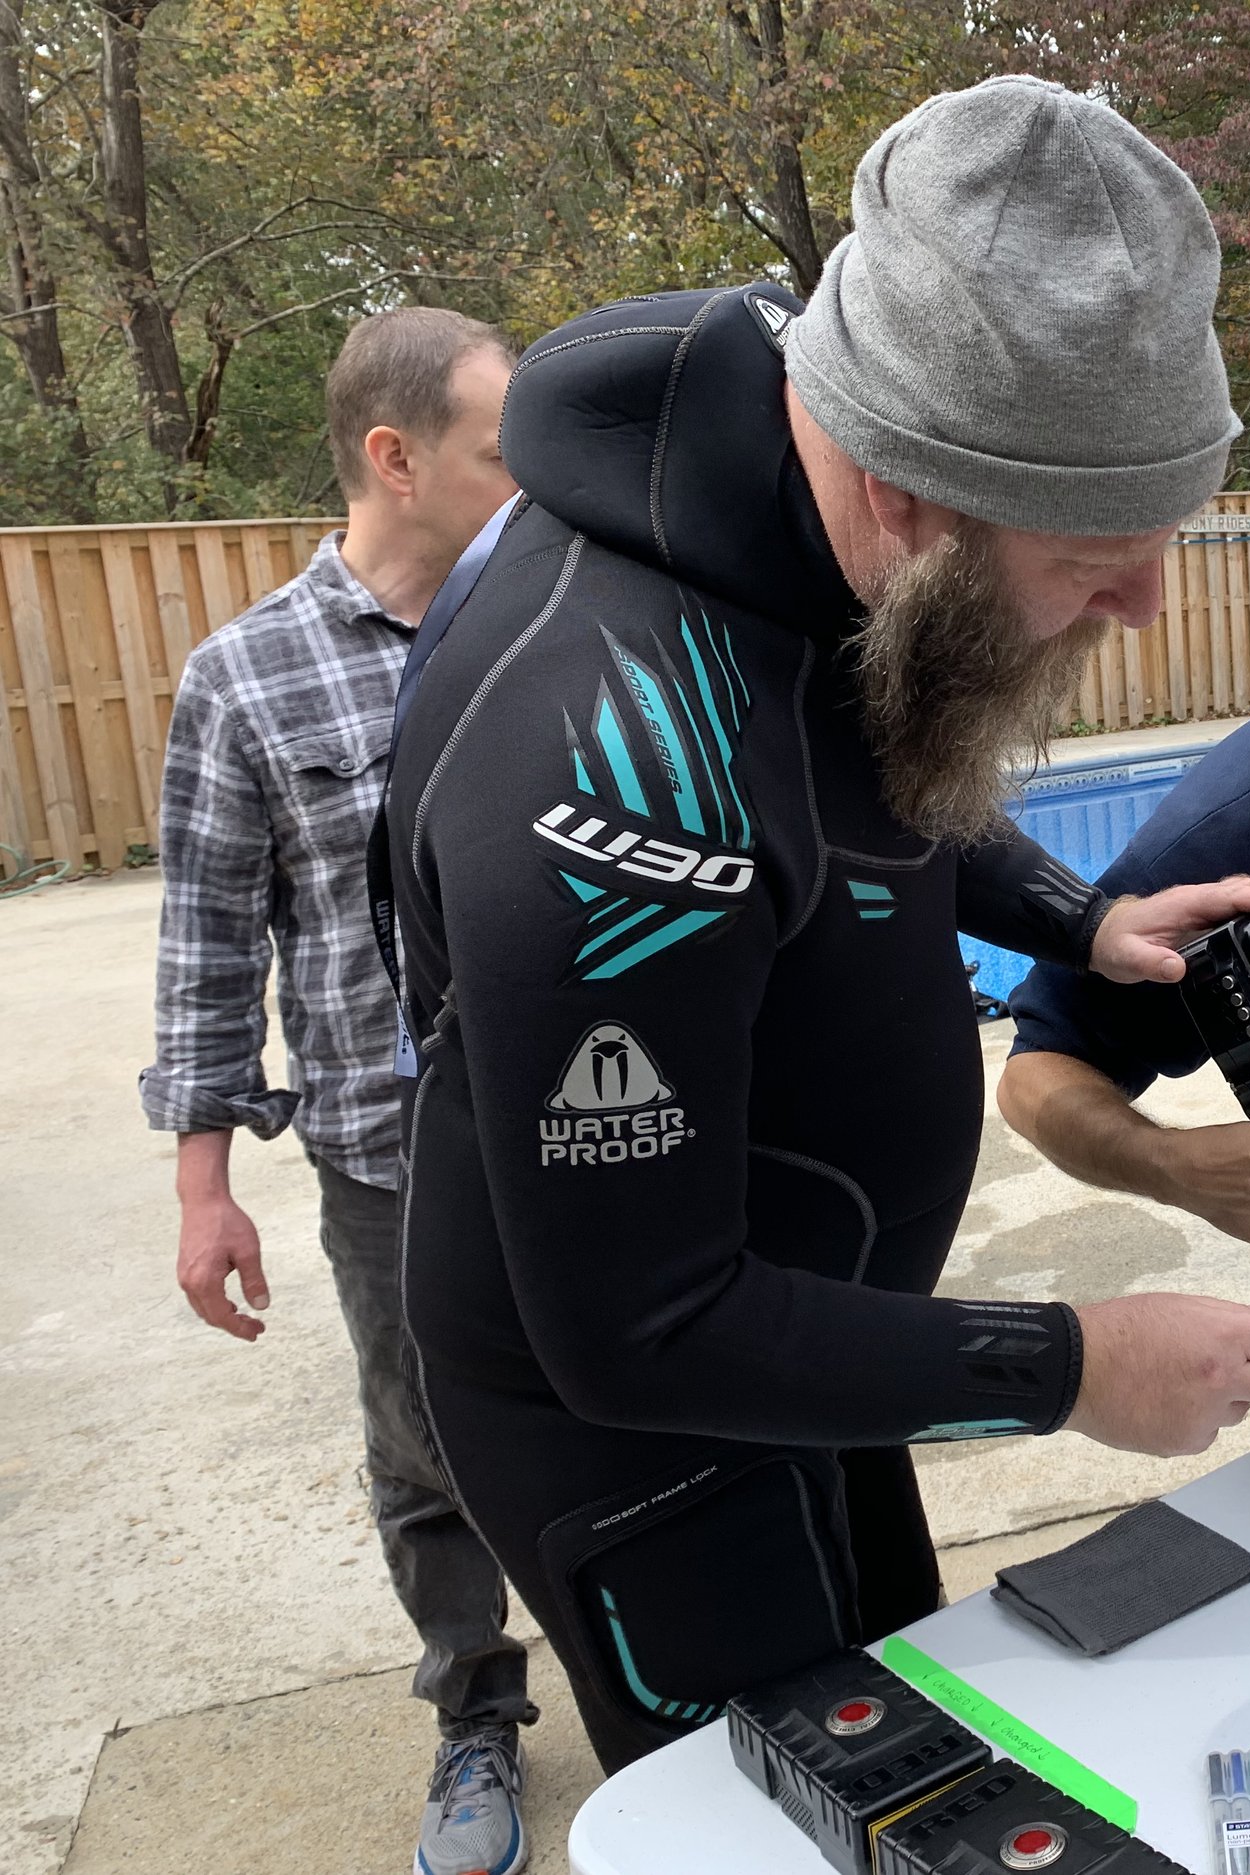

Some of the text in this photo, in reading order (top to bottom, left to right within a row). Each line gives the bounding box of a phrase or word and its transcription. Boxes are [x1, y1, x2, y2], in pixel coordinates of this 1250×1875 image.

[776, 324, 792, 346] WAT
[650, 719, 683, 795] SERIES
[539, 1107, 685, 1142] WATER
[621, 1465, 718, 1519] SOFT FRAME LOCK
[851, 1734, 963, 1793] RED
[905, 1773, 1017, 1841] RED
